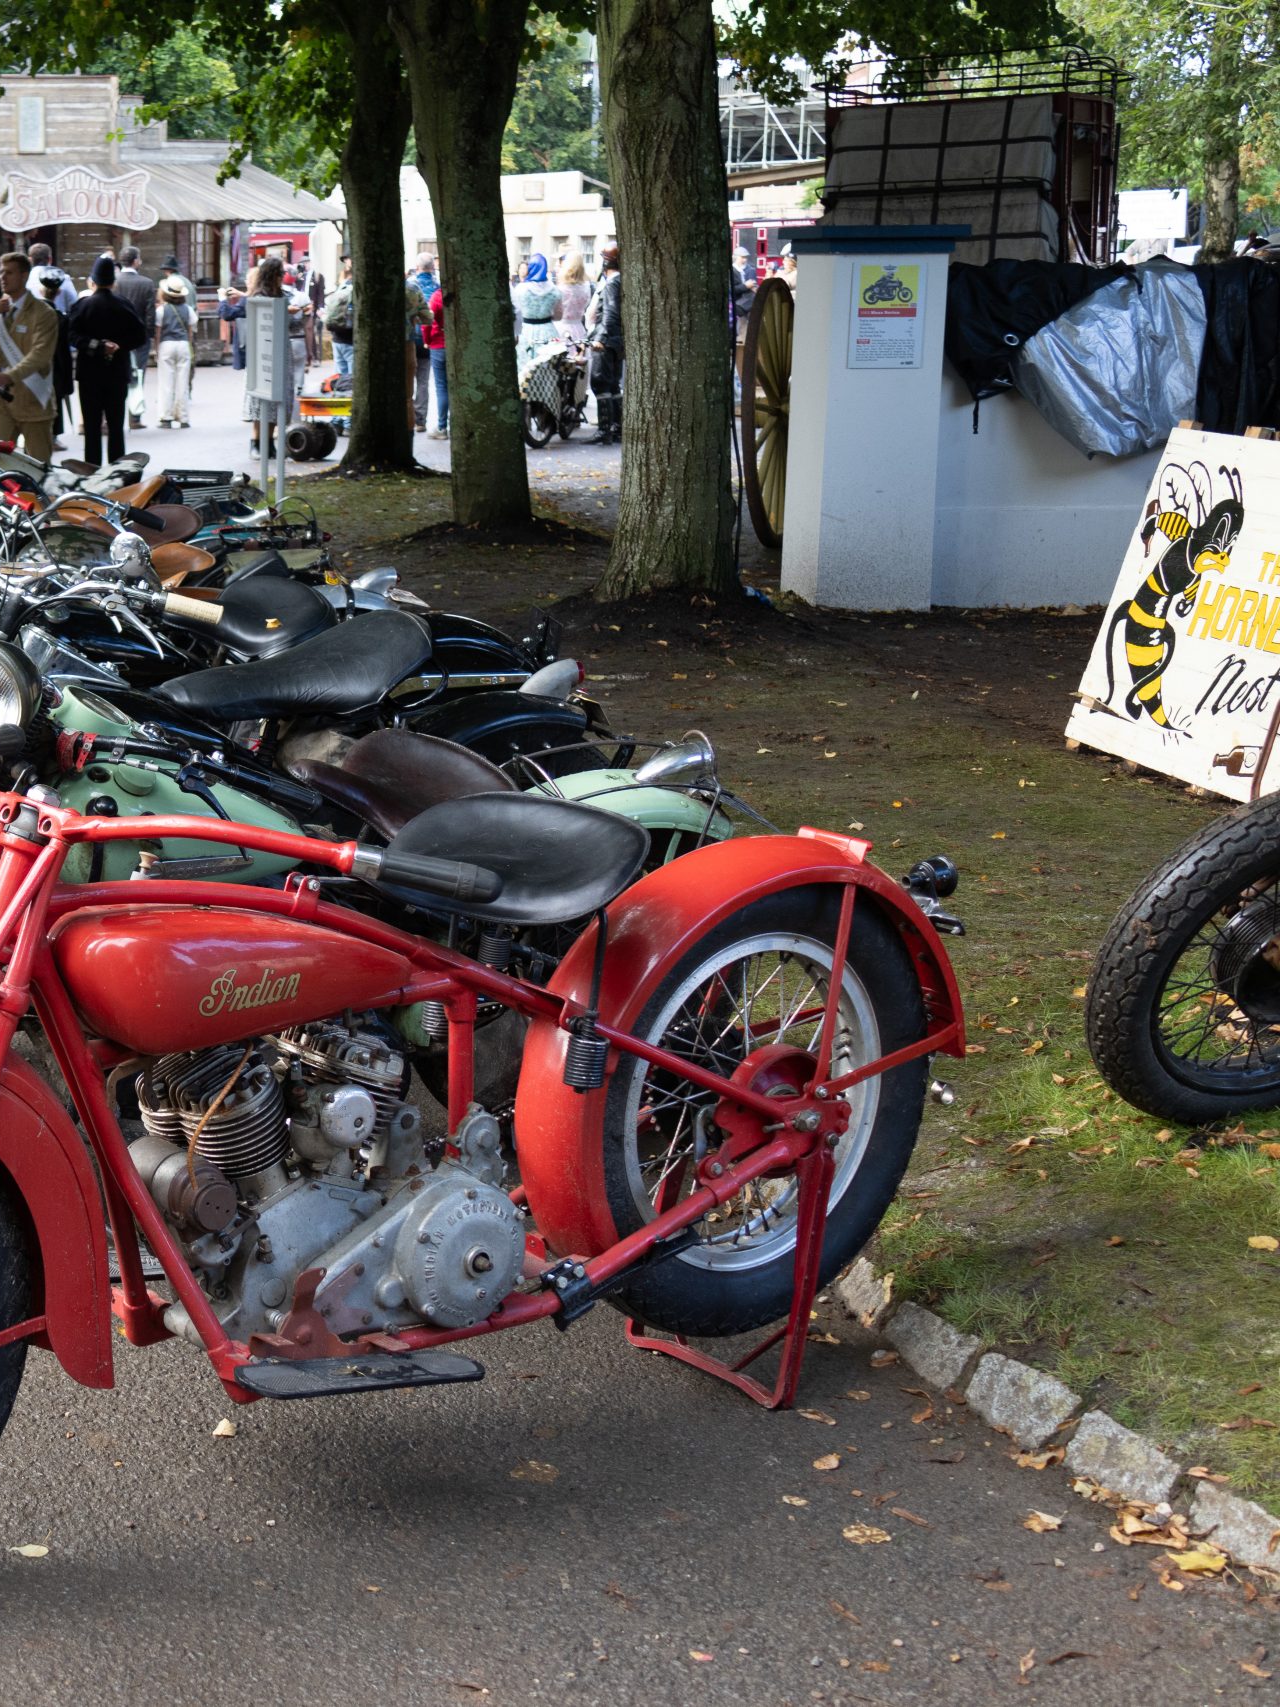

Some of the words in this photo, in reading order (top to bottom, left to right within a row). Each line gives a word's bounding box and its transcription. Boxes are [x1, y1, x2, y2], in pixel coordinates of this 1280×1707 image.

[48, 172, 105, 194] REVIVAL
[12, 190, 144, 227] SALOON
[199, 968, 301, 1017] Indian
